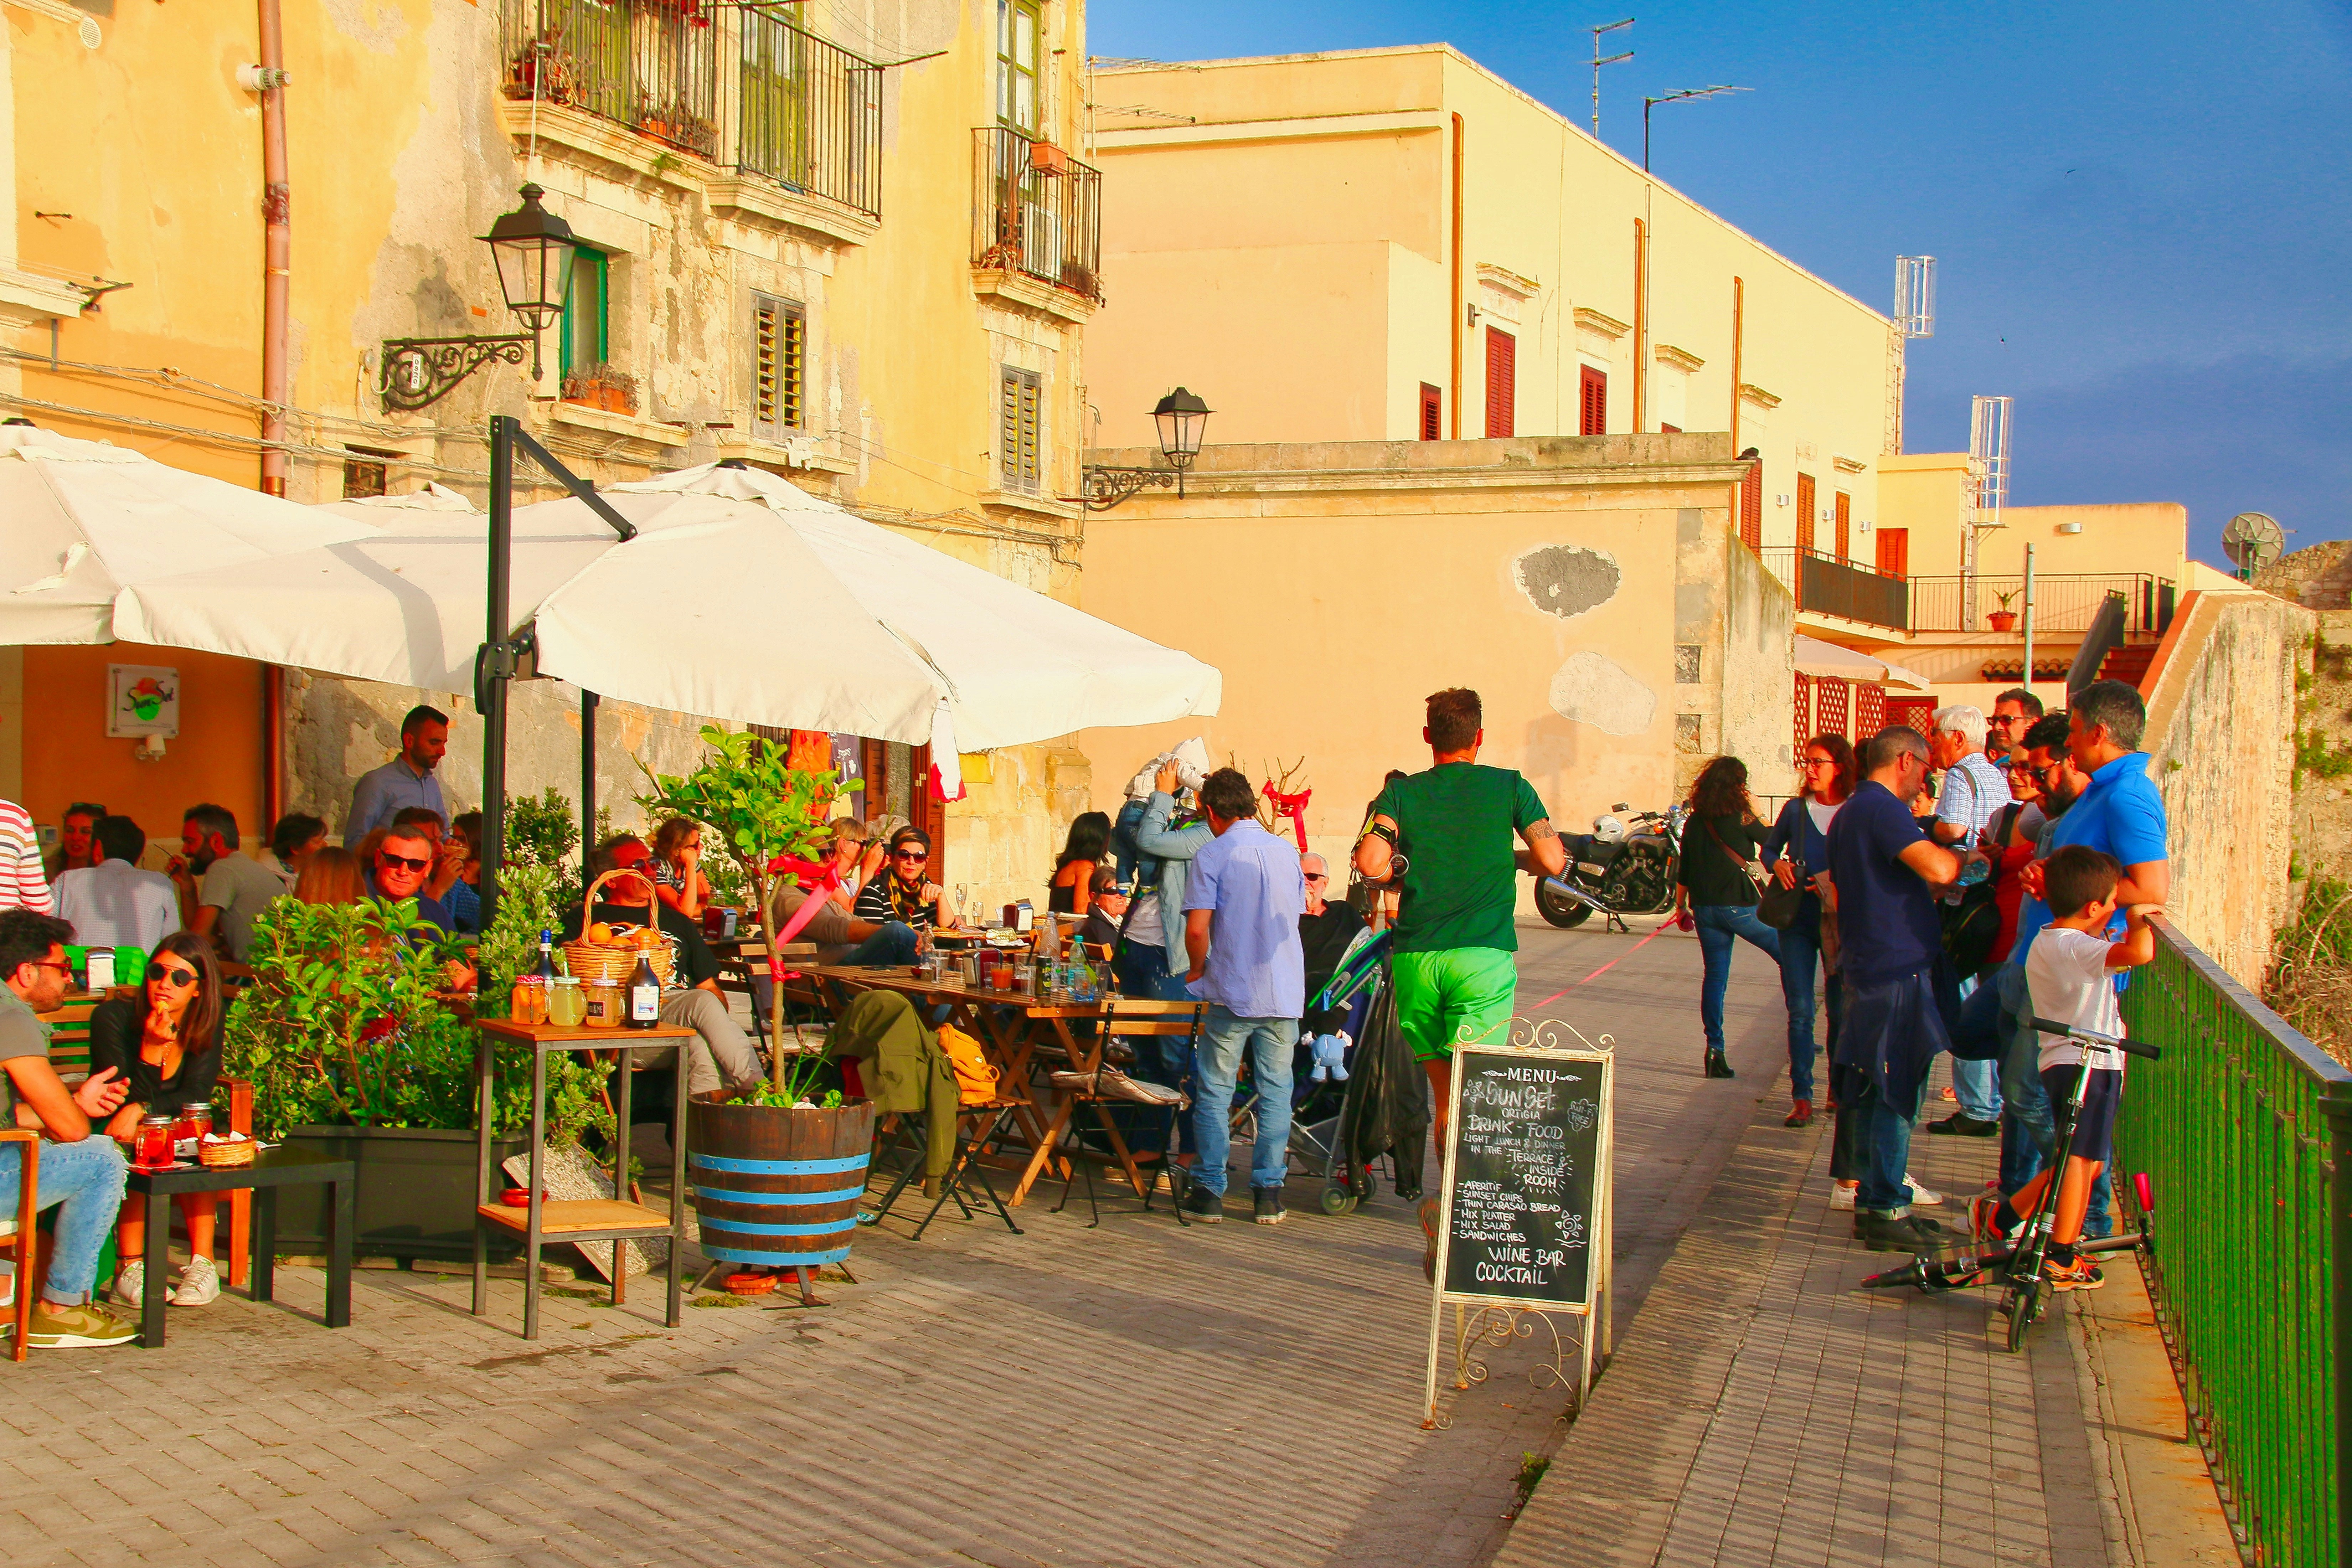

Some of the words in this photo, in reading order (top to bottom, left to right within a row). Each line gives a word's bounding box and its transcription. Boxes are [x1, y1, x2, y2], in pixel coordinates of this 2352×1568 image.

[1507, 1067, 1557, 1083] MENU
[1570, 1111, 1589, 1125] FREE
[1526, 1122, 1563, 1140] FOOD
[1495, 1137, 1521, 1147] LUNCH
[1523, 1138, 1531, 1149] &
[1534, 1140, 1567, 1150] DINNER
[1471, 1145, 1481, 1154] IN
[1484, 1145, 1502, 1155] THE
[1508, 1148, 1554, 1165] TERRACE
[1558, 1156, 1568, 1168] &
[1529, 1165, 1564, 1177] INSIDE
[1523, 1174, 1557, 1188] ROOM
[1463, 1190, 1496, 1201] SUNSET
[1461, 1199, 1484, 1208] THIN
[1486, 1201, 1527, 1211] CARASAO
[1529, 1202, 1561, 1212] BREAD
[1461, 1208, 1479, 1219] MIX
[1481, 1210, 1517, 1221] PLATTER
[1461, 1219, 1479, 1229] MIX
[1481, 1221, 1511, 1231] SALAD
[1535, 1249, 1567, 1267] BAR
